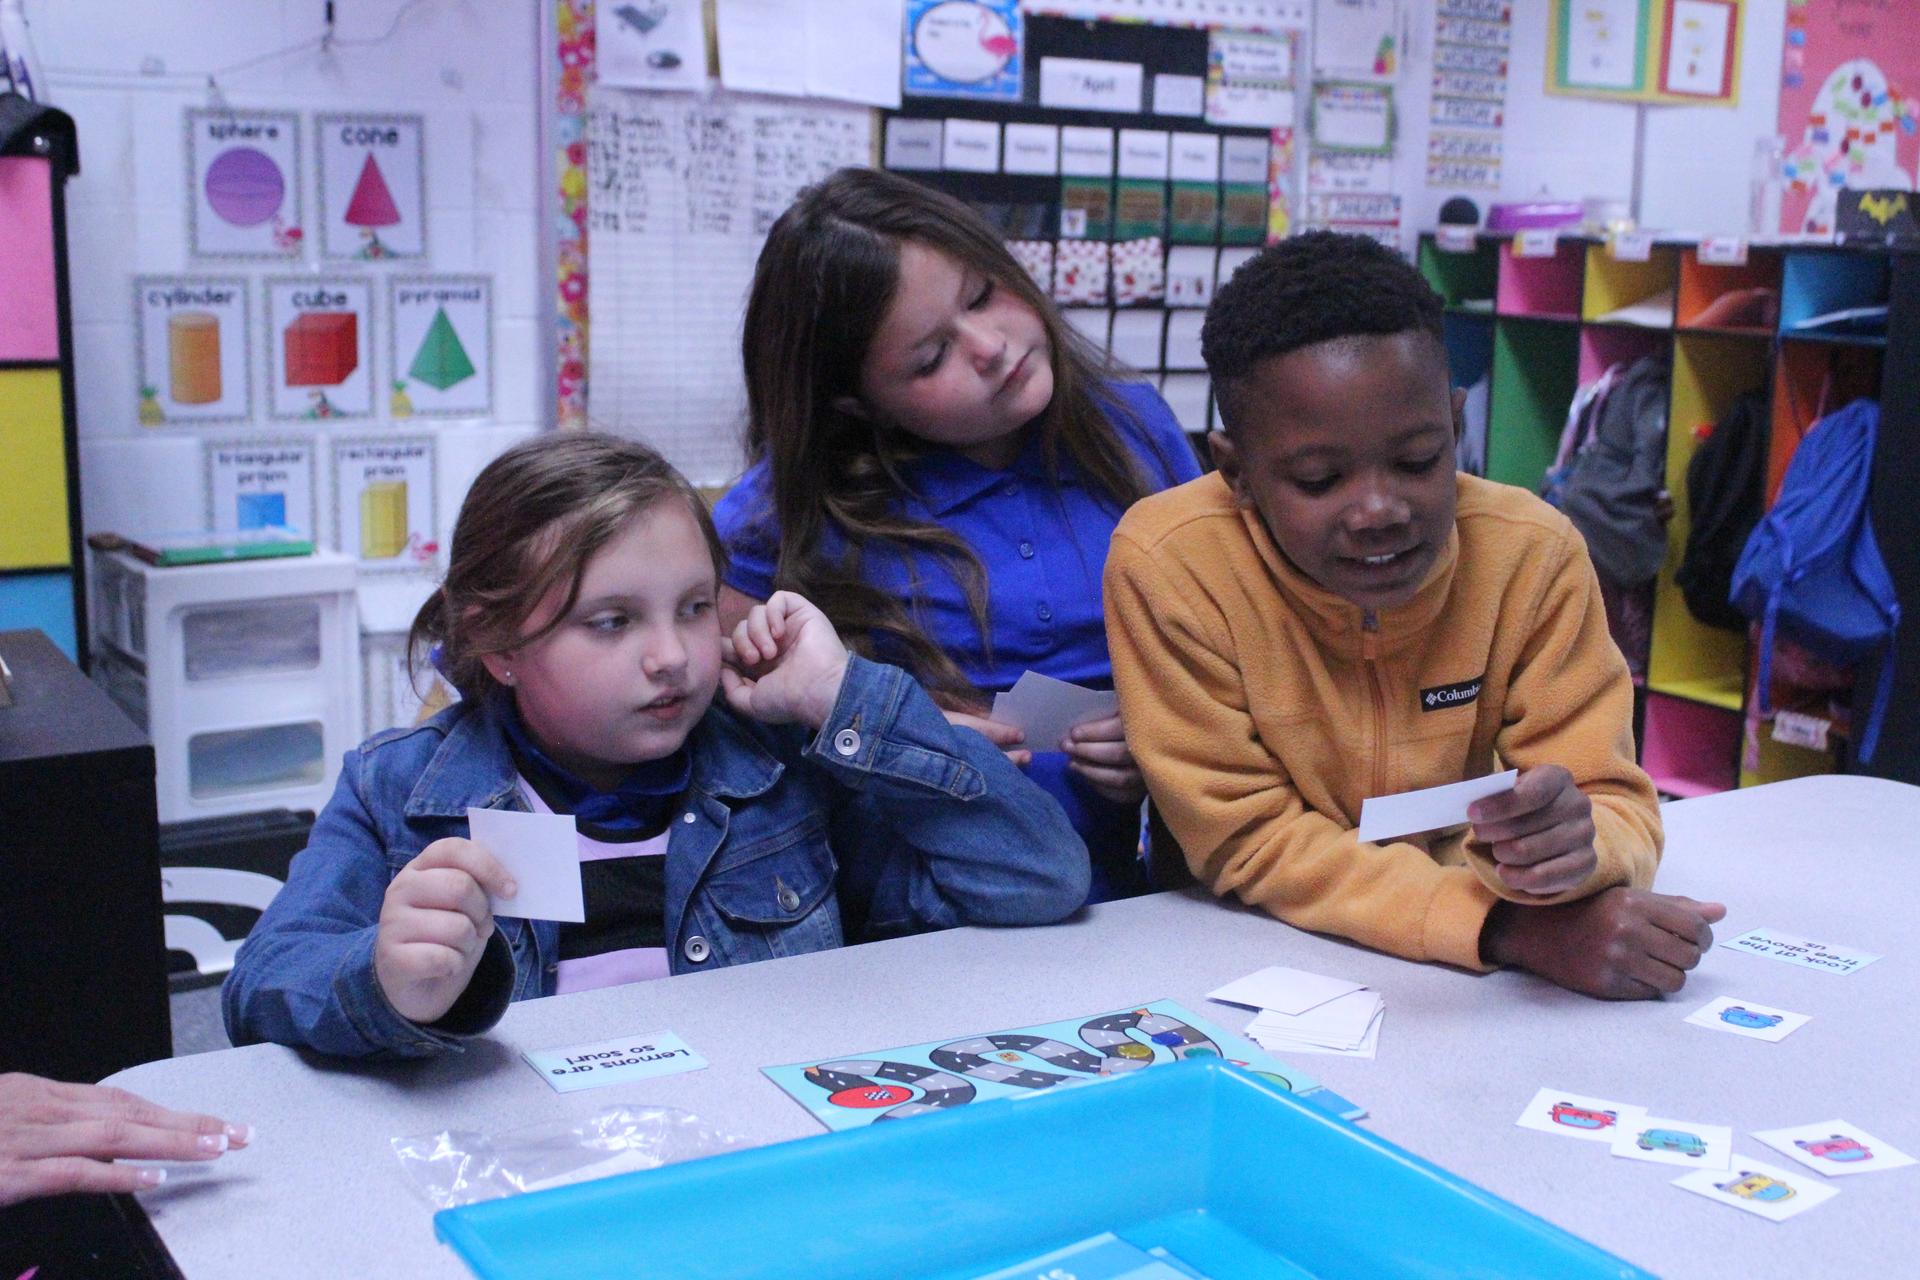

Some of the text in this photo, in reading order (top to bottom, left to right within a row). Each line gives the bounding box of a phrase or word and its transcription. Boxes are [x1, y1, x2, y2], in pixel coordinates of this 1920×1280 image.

[208, 123, 279, 142] sphere
[341, 125, 399, 147] cone
[148, 287, 235, 307] cylinder
[292, 288, 349, 307] cube
[398, 287, 481, 306] pyramid
[218, 449, 304, 468] triangular
[339, 445, 427, 463] rectangular
[237, 468, 289, 485] prism
[363, 462, 406, 479] prism
[1437, 684, 1482, 702] Columb
[1738, 939, 1851, 971] Look at the
[1749, 936, 1860, 966] tree above
[630, 1044, 656, 1054] so
[552, 1049, 690, 1075] Lemons are
